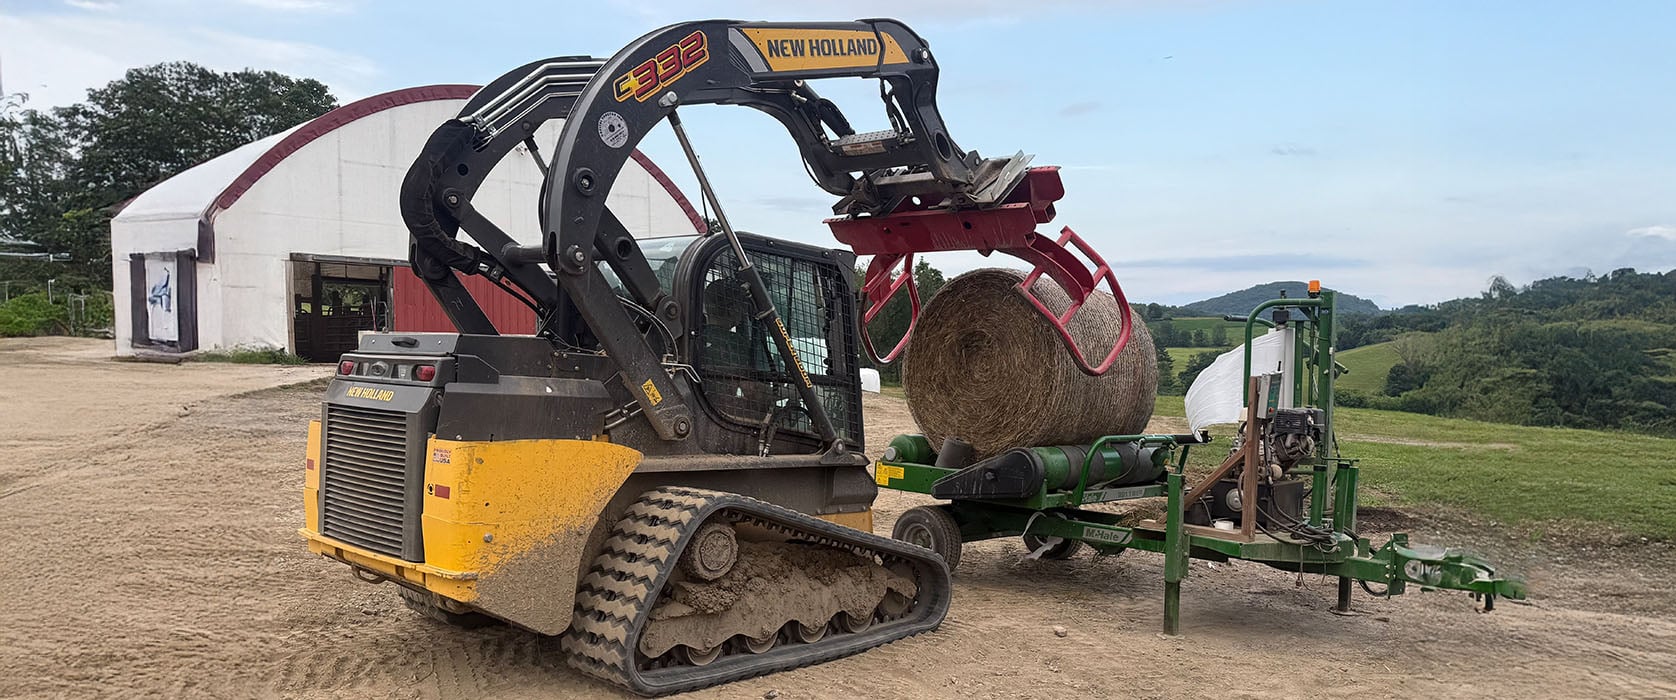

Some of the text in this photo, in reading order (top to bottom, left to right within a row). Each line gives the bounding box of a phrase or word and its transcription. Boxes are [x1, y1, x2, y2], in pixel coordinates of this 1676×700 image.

[767, 38, 877, 58] NEW HOLLAND
[613, 30, 709, 102] C332
[346, 386, 394, 402] NEW HOLLAND
